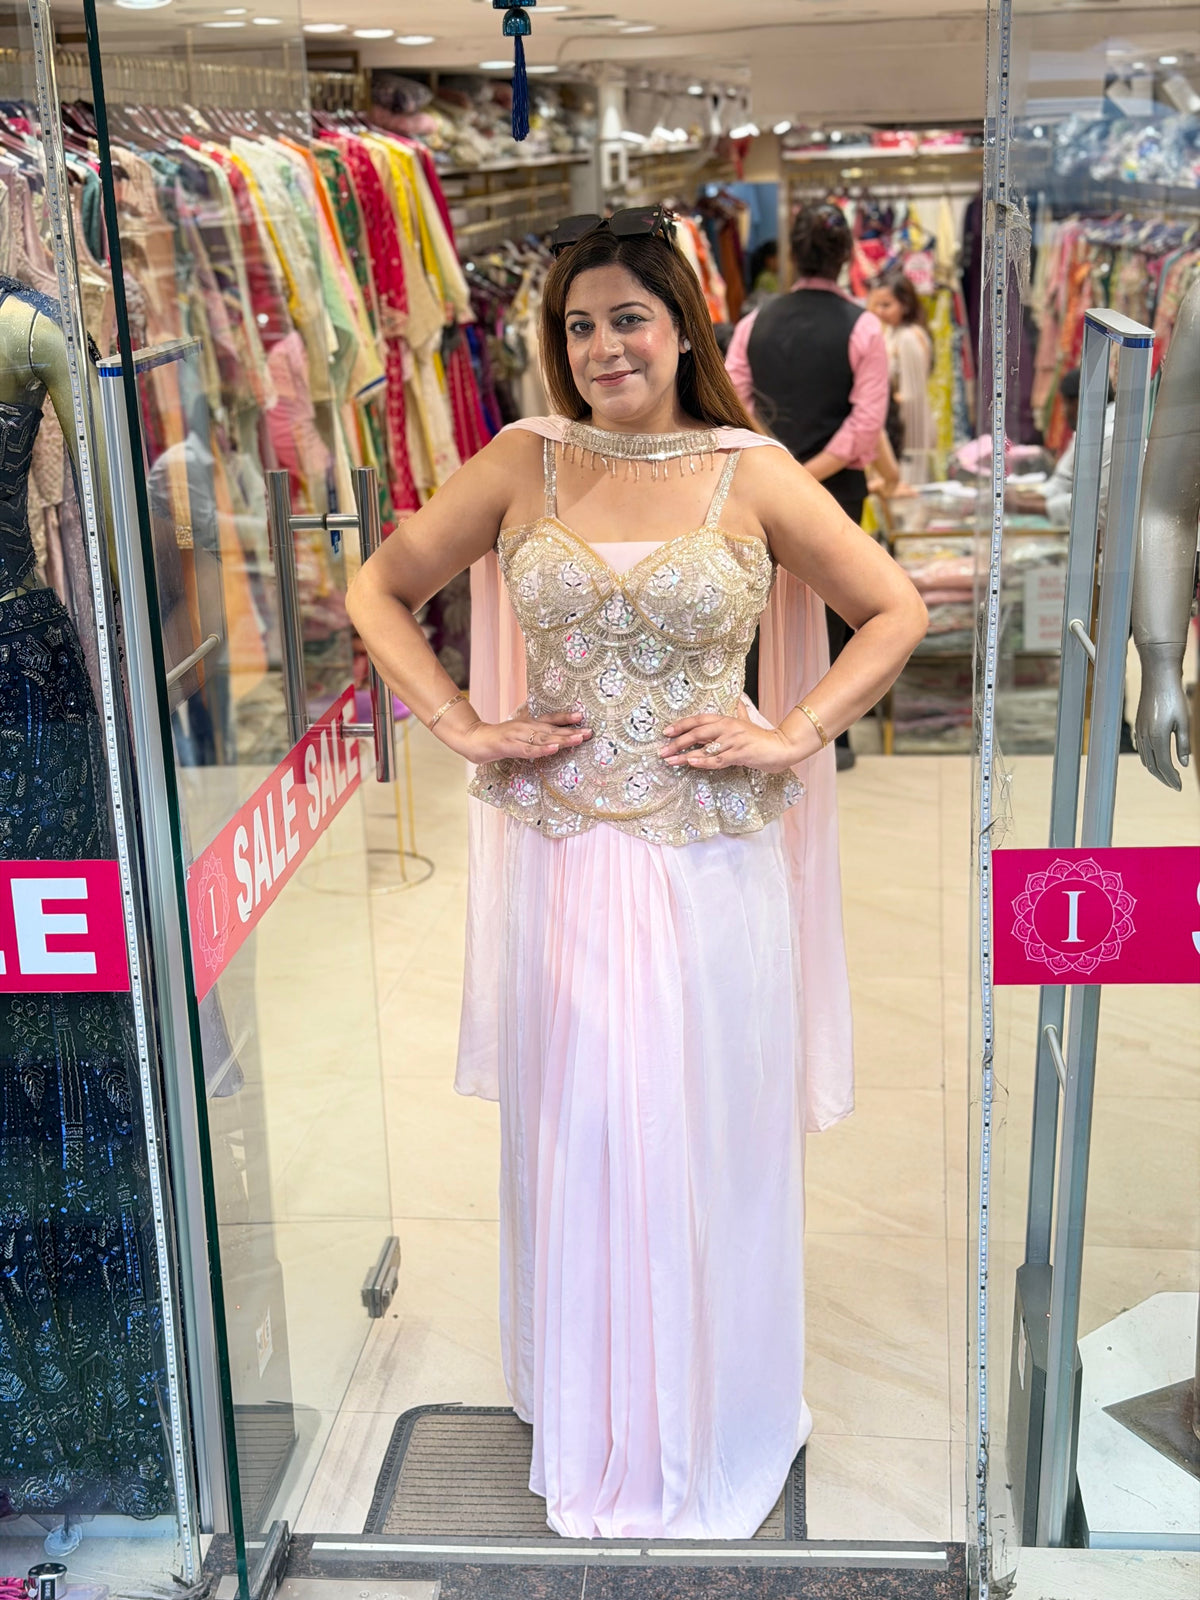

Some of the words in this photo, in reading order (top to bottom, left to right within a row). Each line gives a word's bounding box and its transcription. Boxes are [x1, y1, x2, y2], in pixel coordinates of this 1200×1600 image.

[207, 885, 220, 939] I
[233, 767, 300, 923] SALE
[304, 698, 359, 831] SALE
[0, 878, 97, 974] E
[1061, 890, 1086, 943] I
